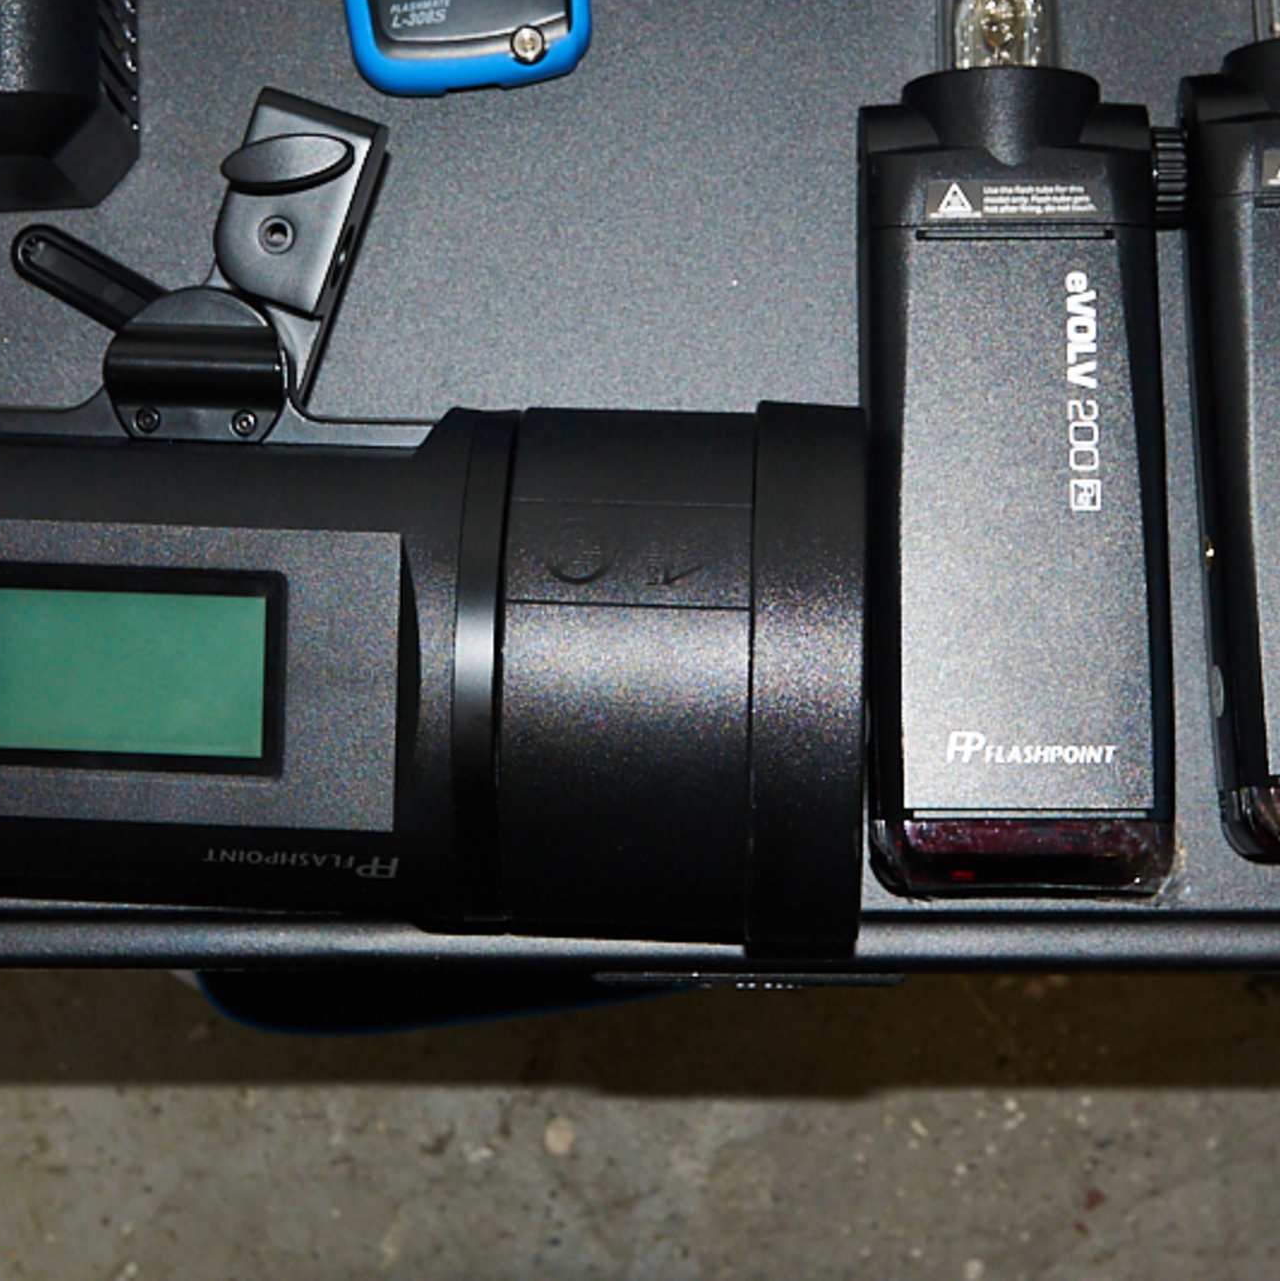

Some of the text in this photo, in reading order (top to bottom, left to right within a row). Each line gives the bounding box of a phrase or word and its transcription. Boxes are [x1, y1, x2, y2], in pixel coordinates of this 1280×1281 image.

[1064, 271, 1098, 389] eVOLV
[1068, 399, 1099, 471] 200
[985, 745, 1117, 764] FLASHPOINT
[201, 848, 356, 869] FLASHPOINT
